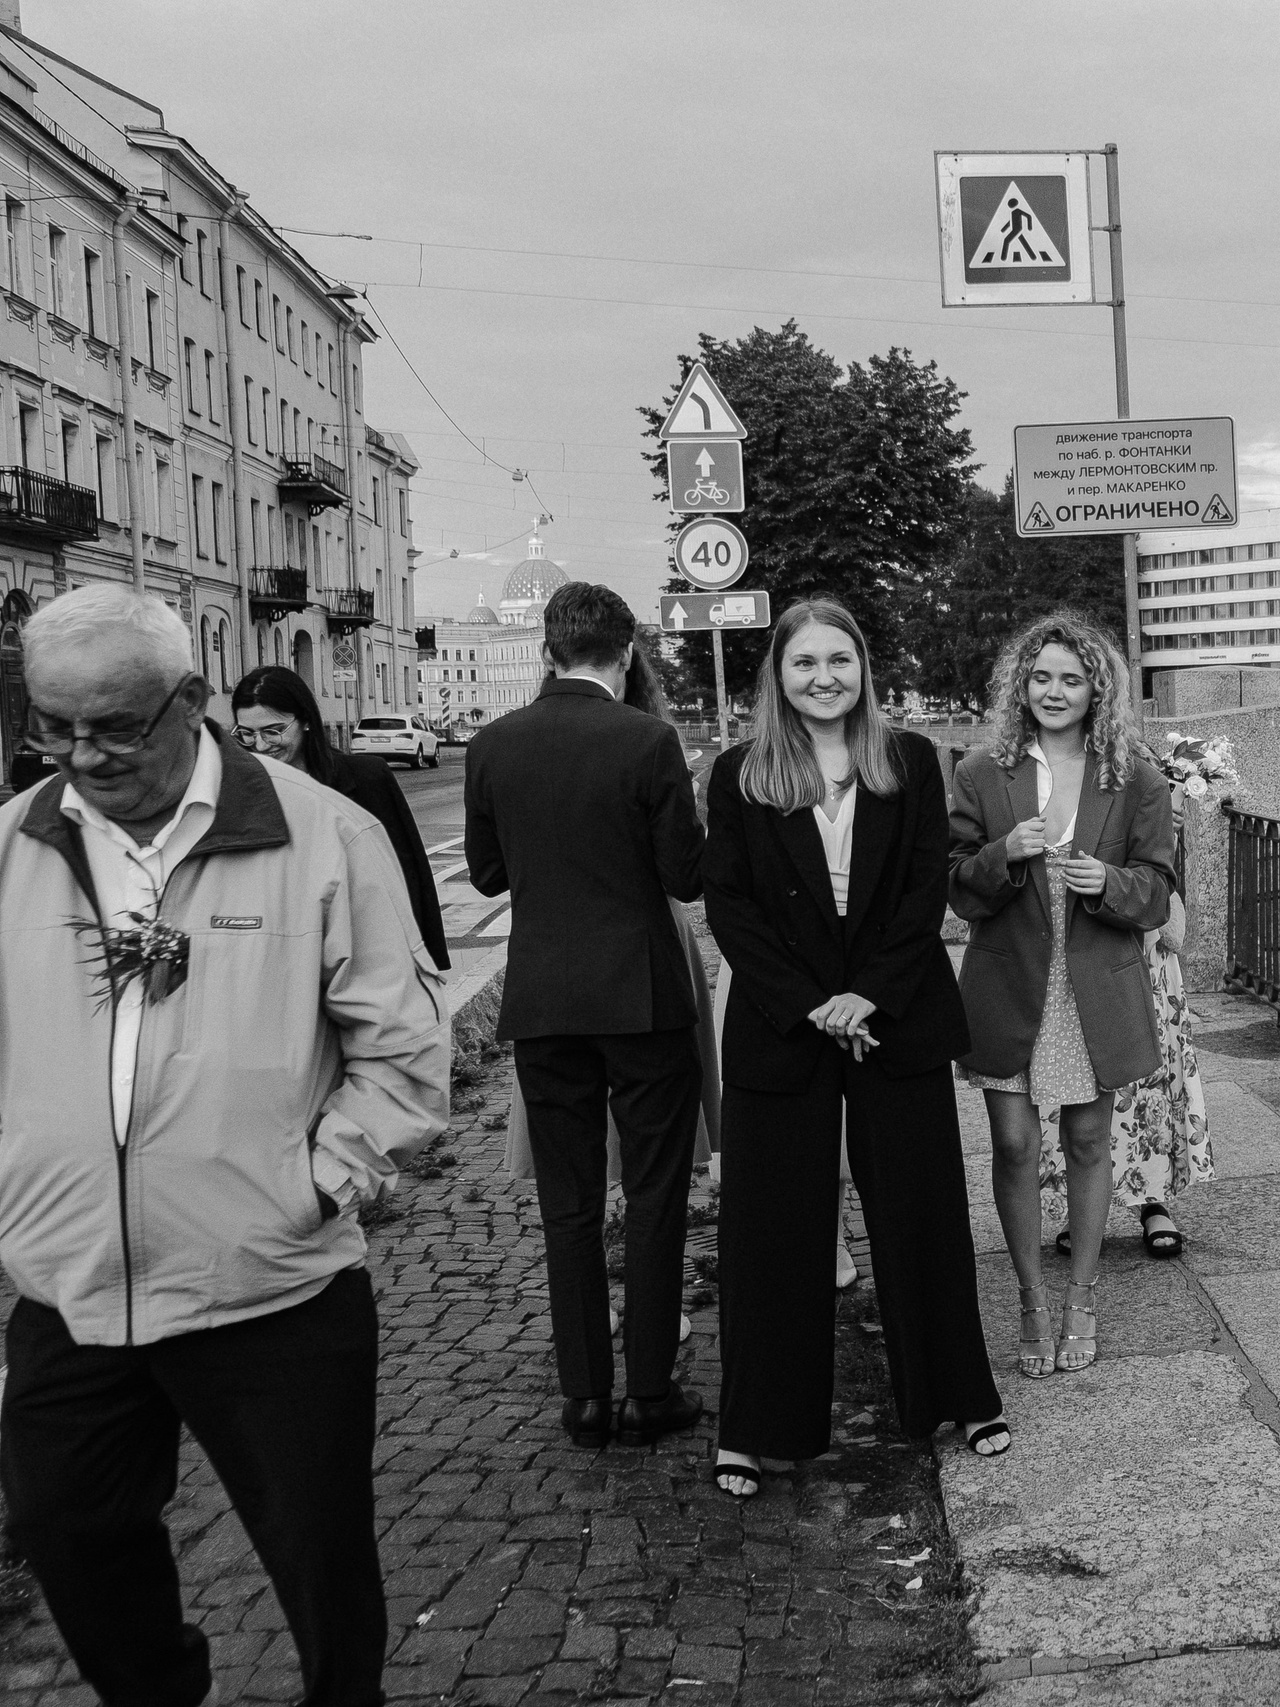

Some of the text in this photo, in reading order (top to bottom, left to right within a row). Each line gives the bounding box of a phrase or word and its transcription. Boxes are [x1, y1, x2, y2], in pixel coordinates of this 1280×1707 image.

[1055, 429, 1193, 445] движение транспорта
[1058, 444, 1192, 462] по наб. р. ФОНТАНКИ
[1033, 462, 1218, 480] между ЛЕРМОНТОВСКИМ пр.
[1067, 480, 1186, 497] и пер. МАКАРЕНКО
[1055, 500, 1200, 522] ОГРАНИЧЕНО
[691, 541, 731, 567] 40
